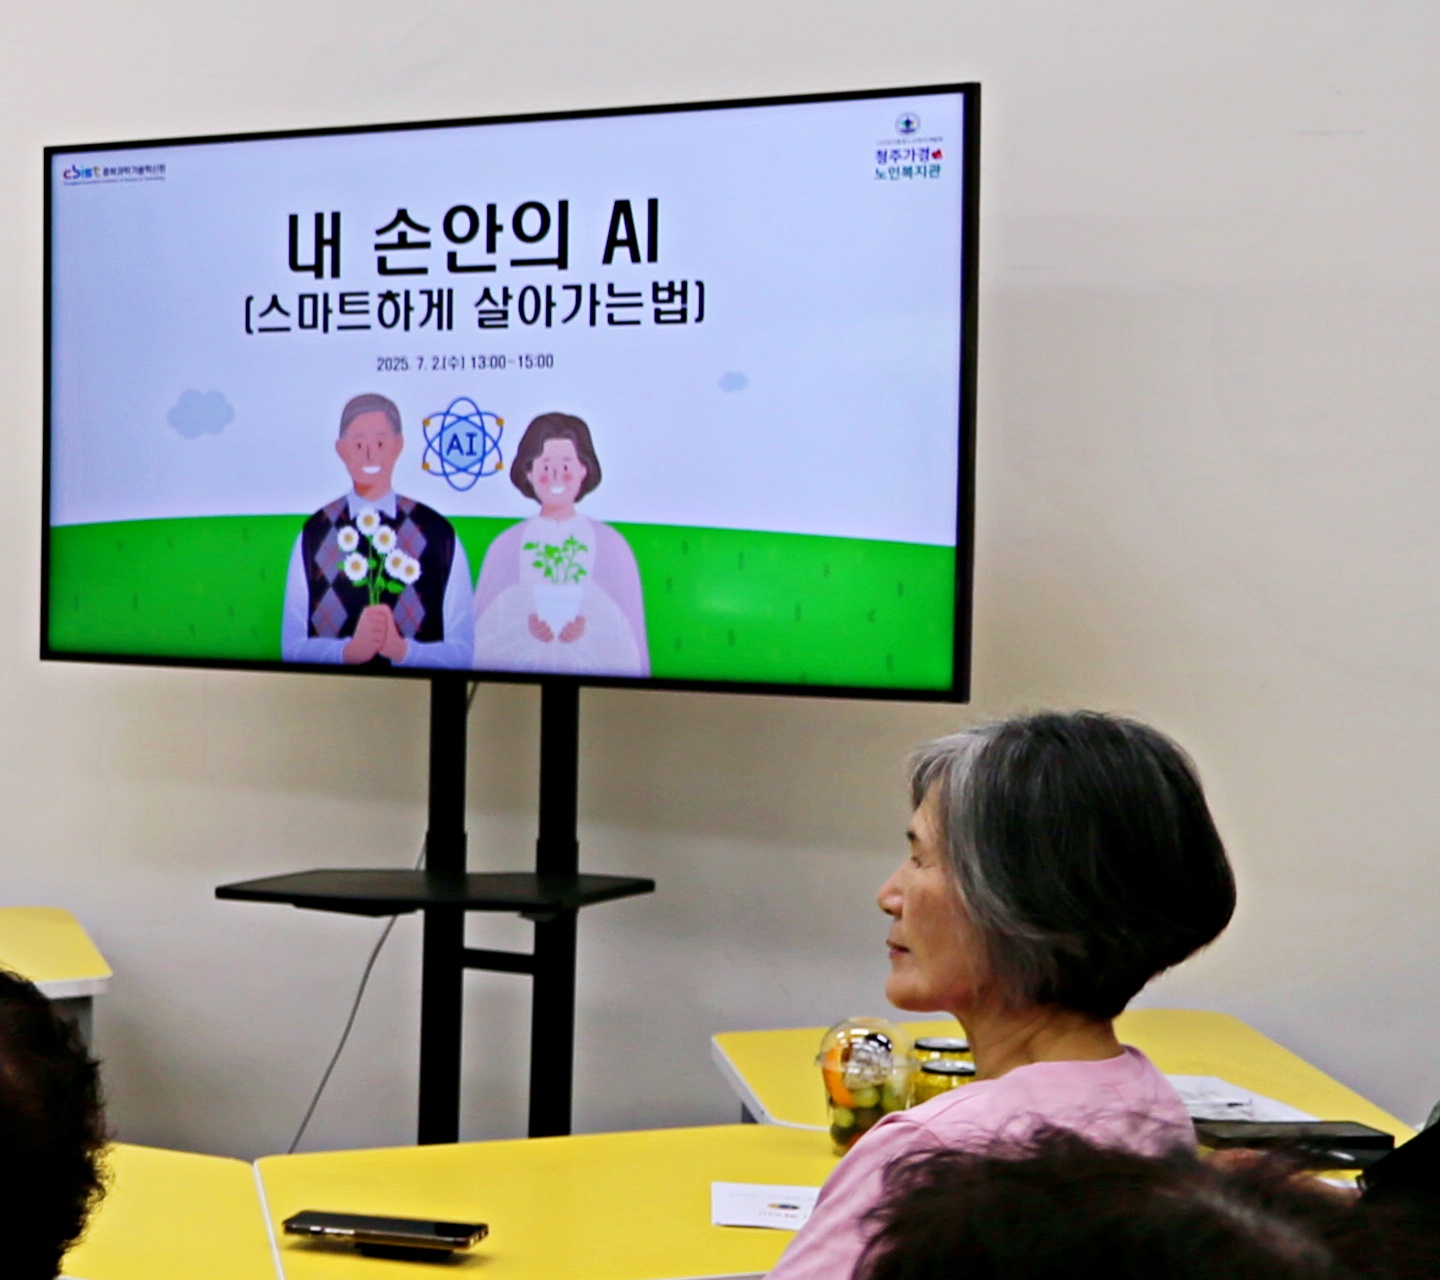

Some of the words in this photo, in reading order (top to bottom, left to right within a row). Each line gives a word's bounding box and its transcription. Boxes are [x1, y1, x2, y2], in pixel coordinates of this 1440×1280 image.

[876, 147, 930, 166] 청주가경
[875, 163, 941, 181] 노인복지관
[287, 211, 341, 279] 내
[373, 199, 569, 276] 손안의
[602, 197, 659, 265] AI
[377, 356, 412, 371] 2025.
[445, 432, 479, 457] AI
